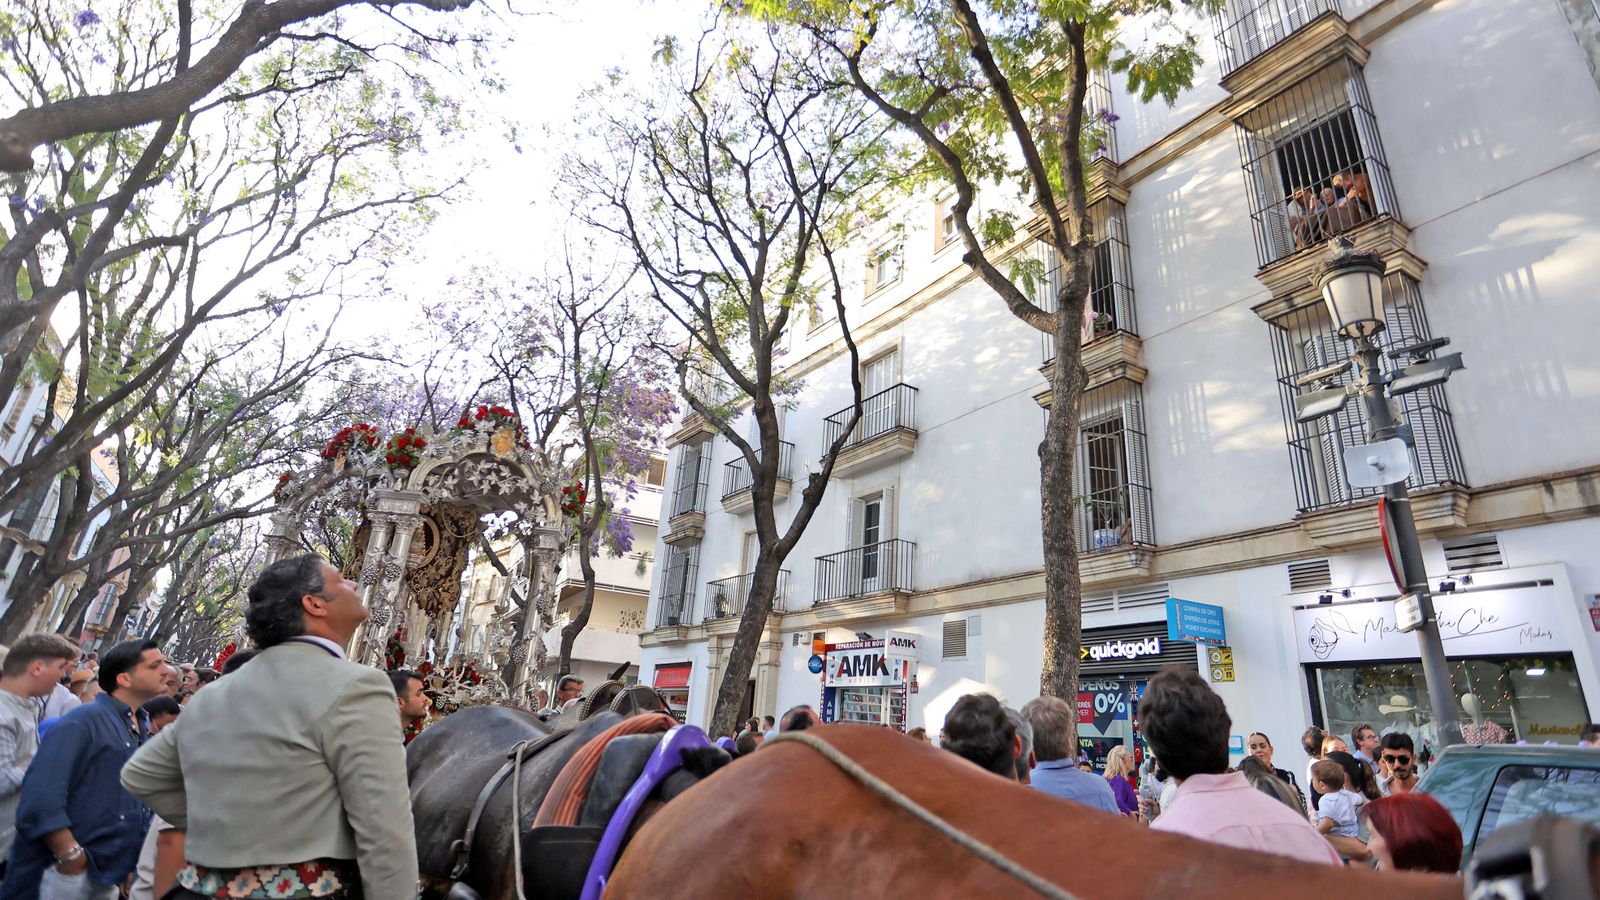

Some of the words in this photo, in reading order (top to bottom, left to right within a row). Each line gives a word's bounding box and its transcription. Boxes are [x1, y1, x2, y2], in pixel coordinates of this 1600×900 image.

[1457, 608, 1499, 636] Che
[889, 637, 916, 648] AMK
[1089, 637, 1160, 661] quickgold
[837, 653, 889, 677] AMK
[1094, 692, 1126, 713] 0%
[1079, 739, 1093, 747] NTA
